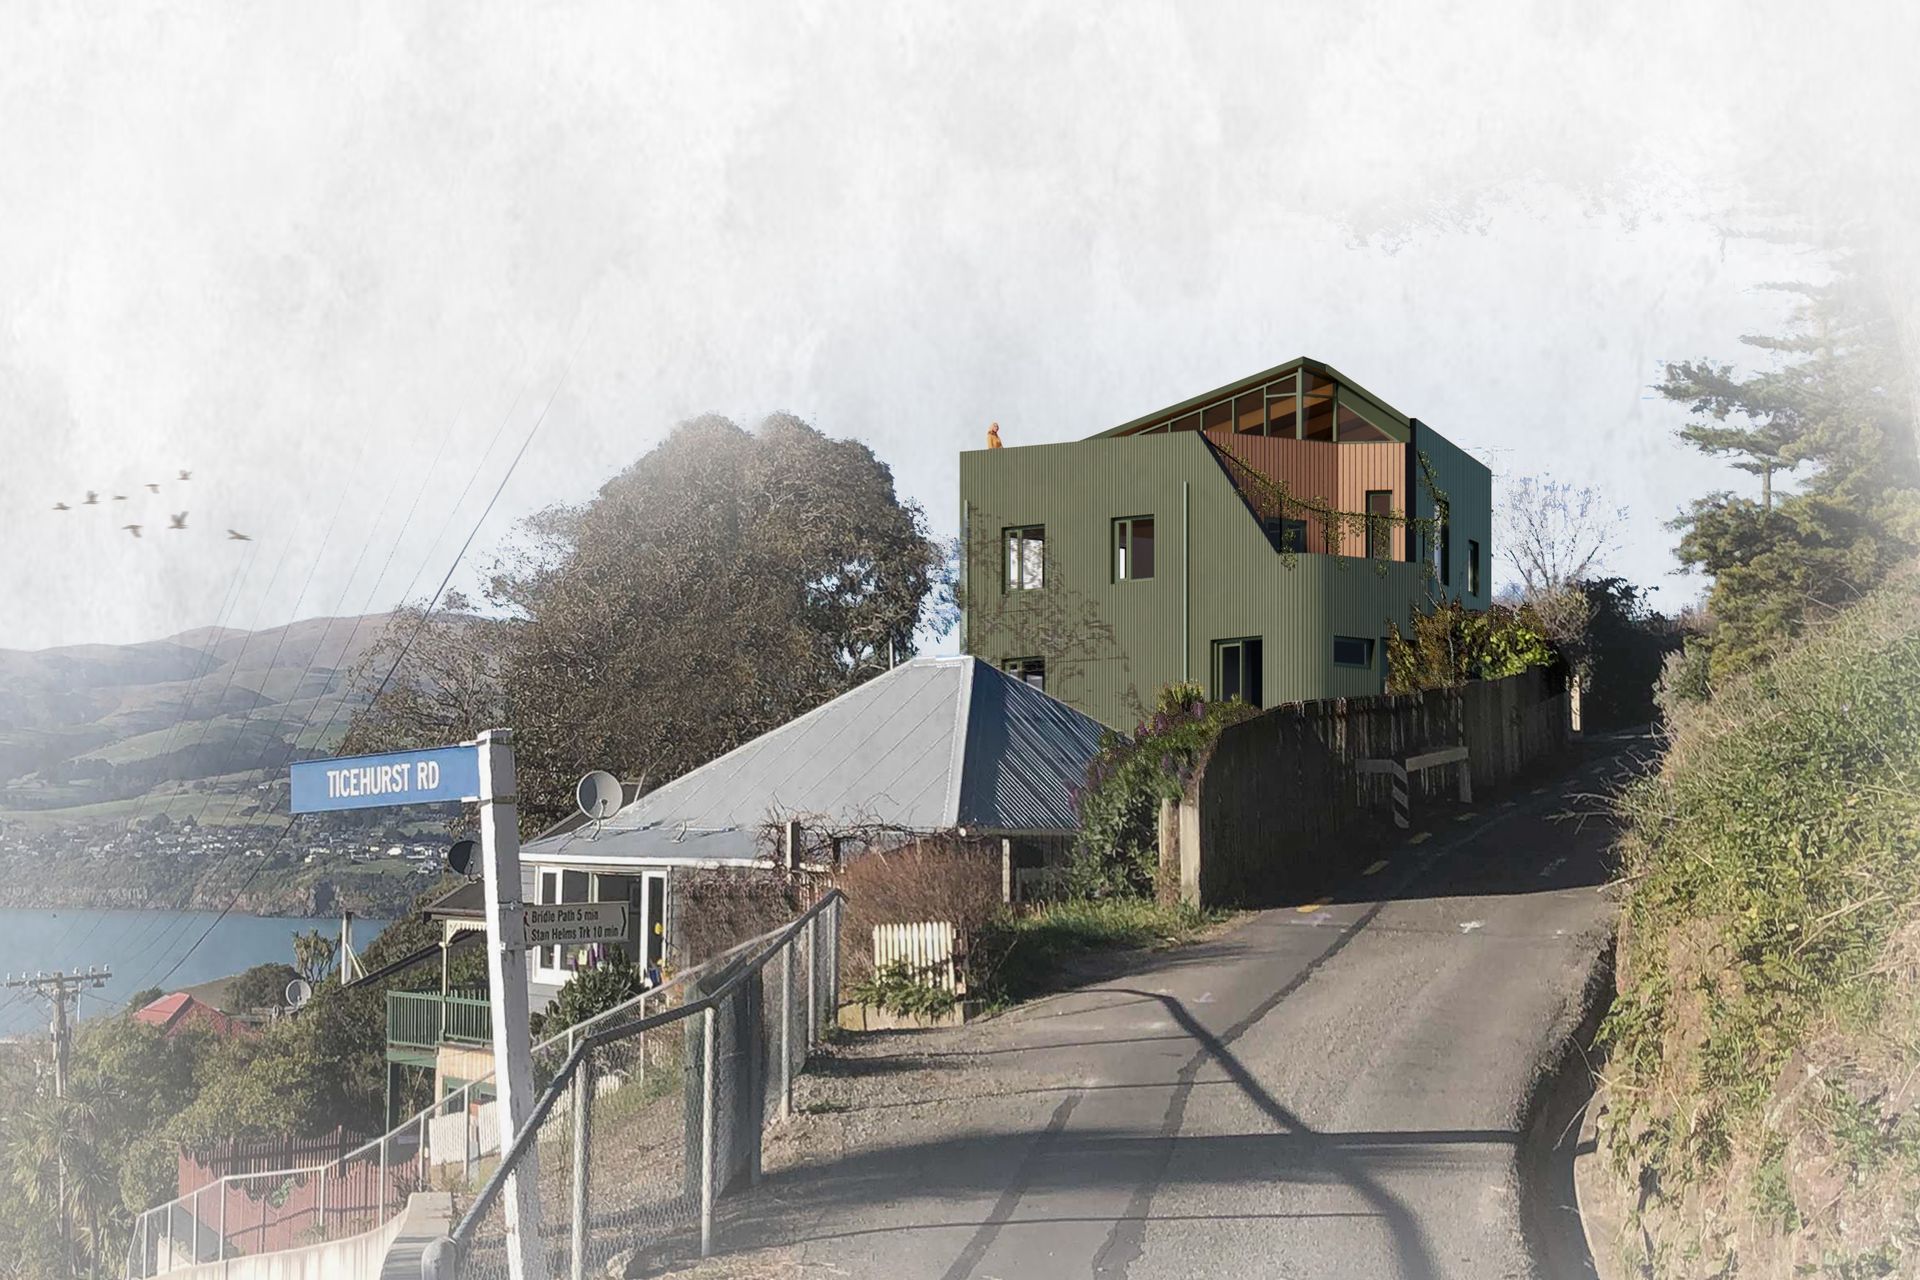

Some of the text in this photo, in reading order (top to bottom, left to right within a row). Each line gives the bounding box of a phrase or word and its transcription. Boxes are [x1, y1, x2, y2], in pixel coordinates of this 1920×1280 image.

[327, 760, 439, 798] TICEHURST RD
[531, 908, 599, 924] Bridle Path 5 min
[531, 925, 619, 941] Stan Helms Trk 10 min
